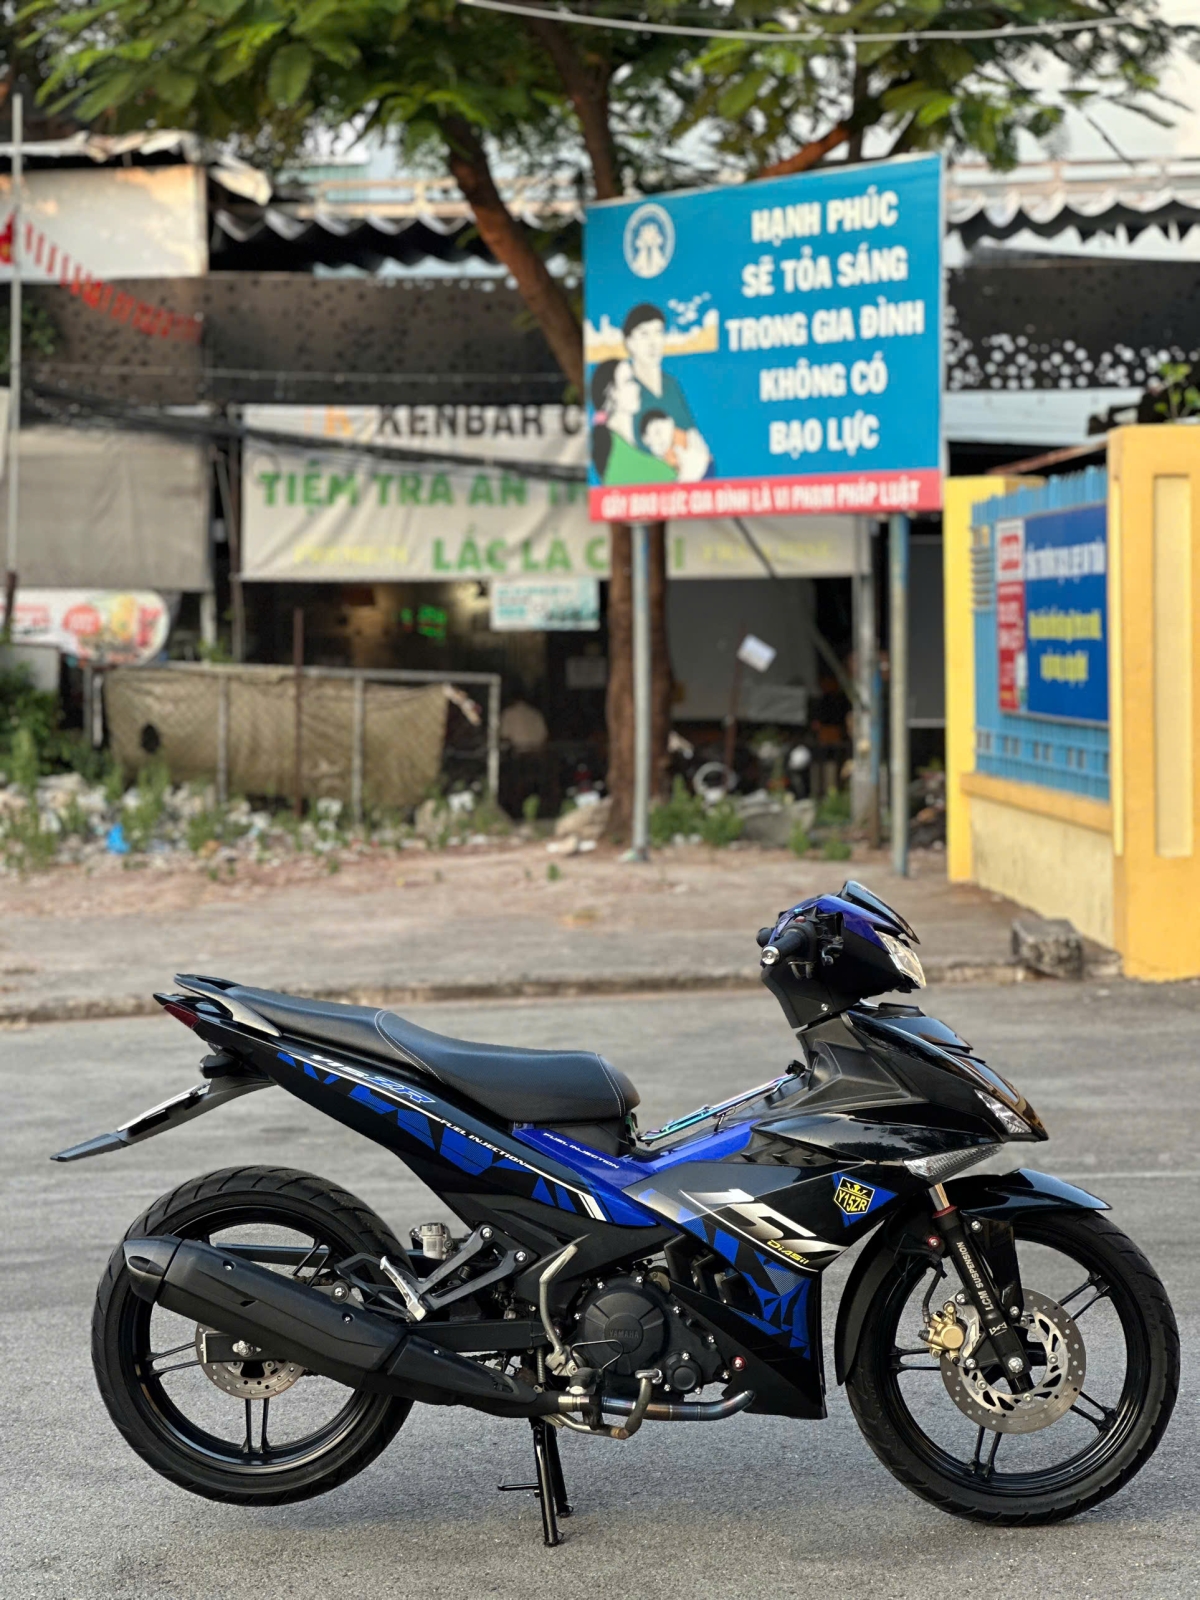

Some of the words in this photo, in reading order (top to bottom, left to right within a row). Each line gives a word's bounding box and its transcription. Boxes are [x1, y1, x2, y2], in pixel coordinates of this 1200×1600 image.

[752, 201, 822, 247] HẠNH
[826, 185, 899, 234] PHÚC
[741, 254, 776, 298] SẼ
[780, 245, 833, 294] TỎA
[837, 242, 909, 287] SÁNG
[725, 311, 808, 352] TRONG
[811, 306, 855, 345] GIA
[859, 295, 925, 340] ĐÌNH
[759, 357, 848, 402] KHÔNG
[850, 350, 888, 396] CÓ
[769, 418, 823, 460] BẠO
[826, 409, 880, 457] LỰC
[751, 480, 772, 511] LÀ
[836, 475, 879, 508] PHÁP
[879, 473, 921, 509] LUẬT
[441, 1119, 467, 1136] FUEL
[468, 1134, 527, 1167] INJECTION
[543, 1132, 569, 1146] FUEL
[569, 1144, 620, 1169] INJECTION
[838, 1189, 868, 1213] Y15ZR
[956, 1241, 985, 1290] SUSPENSION
[977, 1289, 995, 1311] LCM
[609, 1329, 639, 1339] YAMAHA
